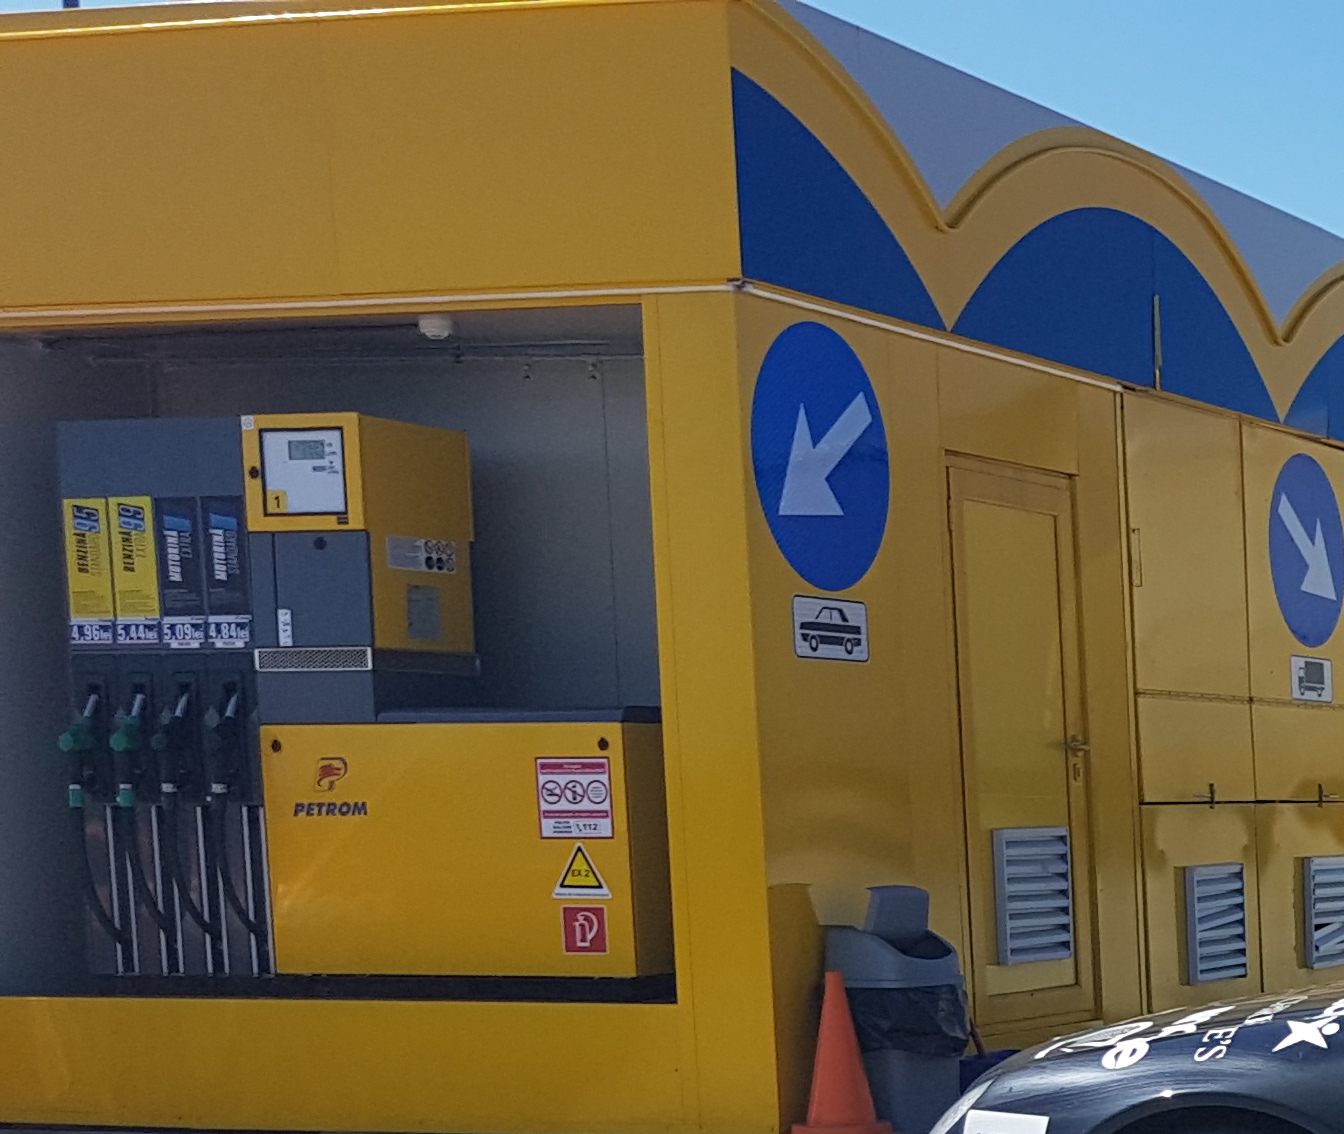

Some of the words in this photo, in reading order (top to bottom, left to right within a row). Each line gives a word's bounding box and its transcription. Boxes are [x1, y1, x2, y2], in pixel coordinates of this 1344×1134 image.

[274, 496, 281, 508] 1
[293, 801, 368, 817] PETROM
[583, 823, 598, 831] 112
[571, 869, 582, 877] EX
